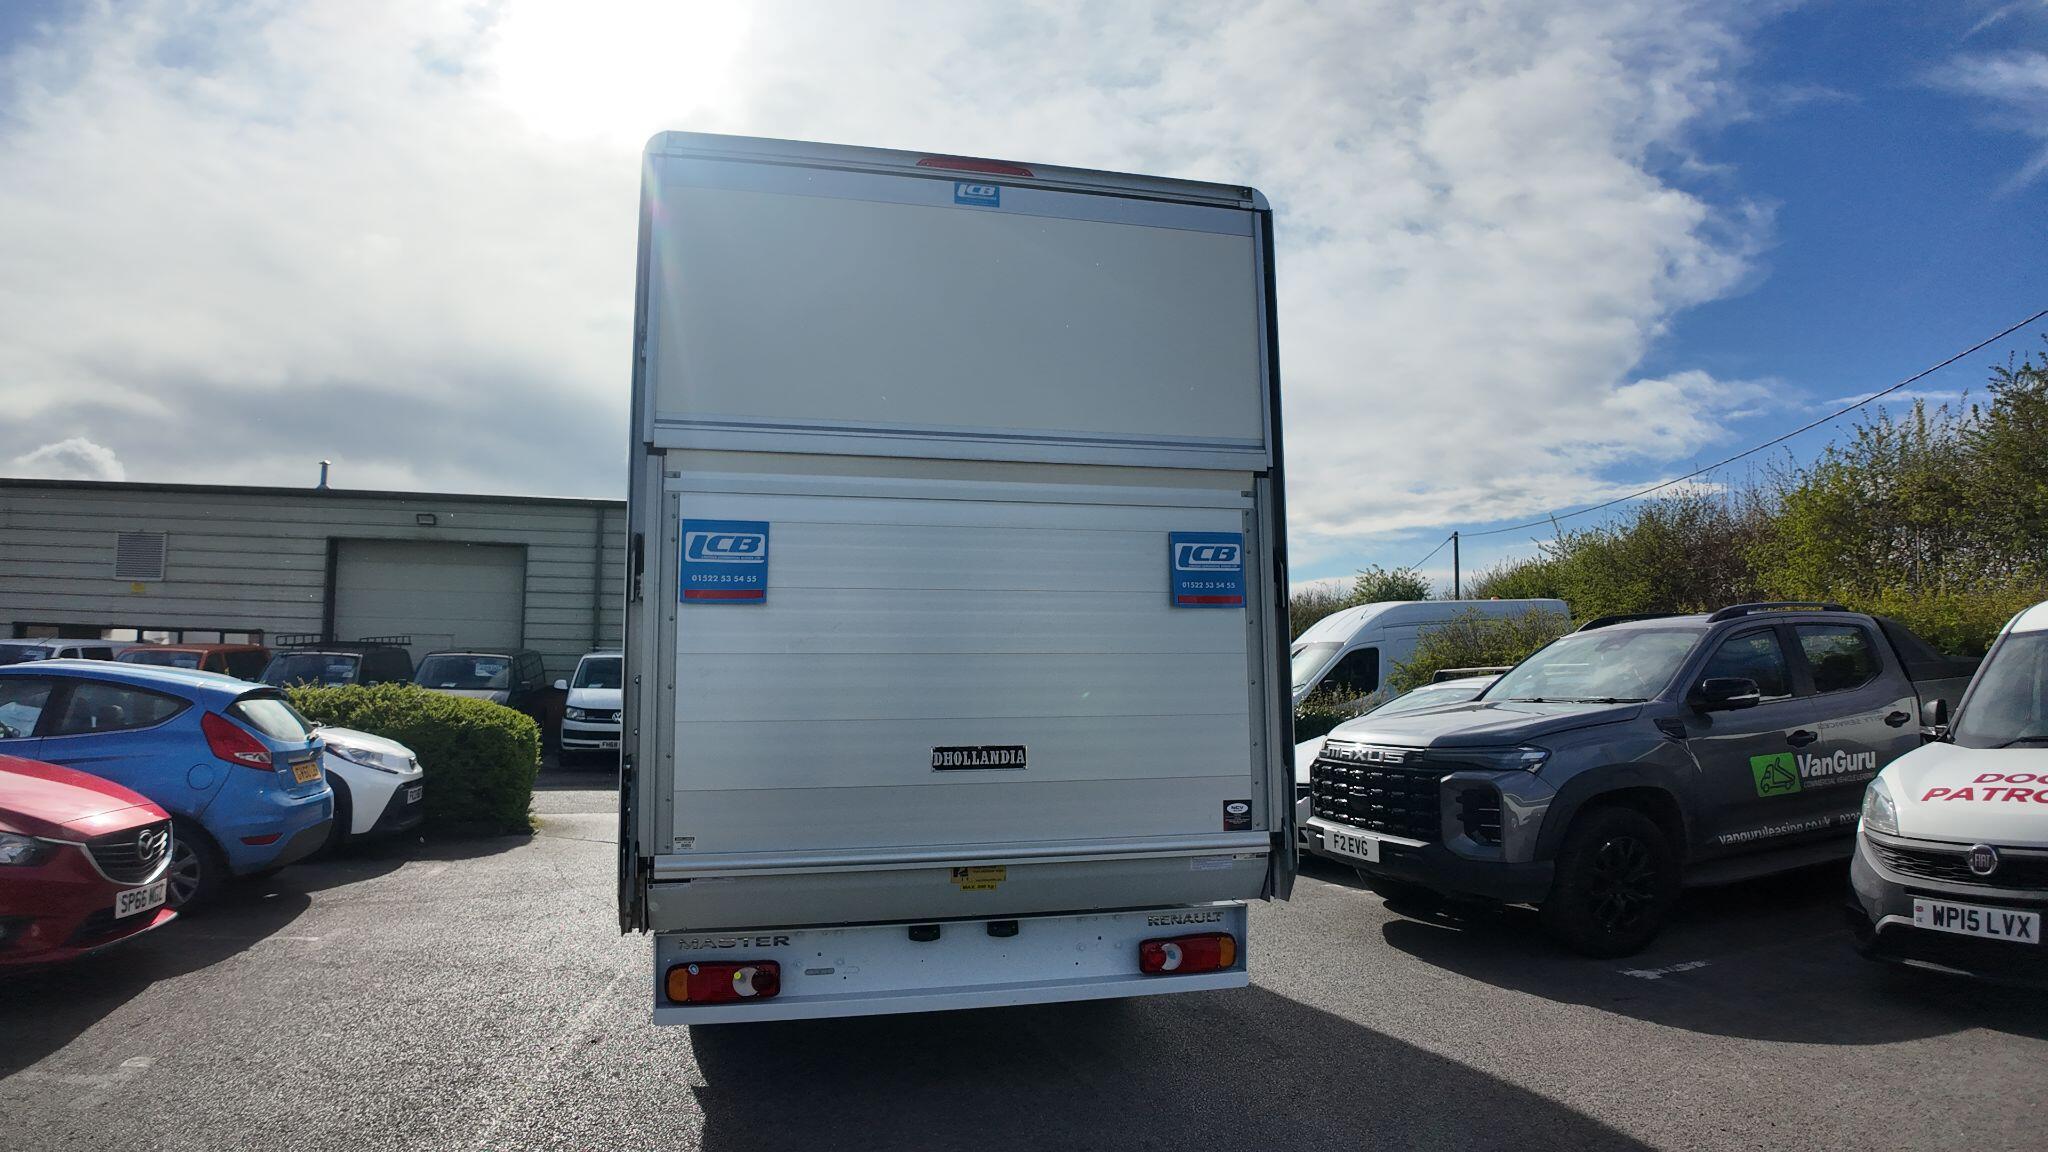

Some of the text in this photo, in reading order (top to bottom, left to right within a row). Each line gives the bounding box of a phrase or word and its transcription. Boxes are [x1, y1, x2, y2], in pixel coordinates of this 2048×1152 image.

[958, 184, 996, 197] LCB
[689, 535, 762, 559] LCB
[1178, 545, 1237, 567] LCB
[691, 574, 757, 583] 01522 53 54 55
[1182, 581, 1204, 589] 01522
[932, 749, 1026, 766] DHOLLANDIA
[1327, 746, 1405, 764] MAXUS
[1797, 749, 1876, 778] VanGuru
[1333, 833, 1369, 857] F2 EVG
[1974, 853, 1991, 867] FIAT
[121, 890, 148, 914] SP66
[1148, 911, 1224, 927] RENAULT
[1932, 905, 2031, 938] WP15 LVX
[680, 935, 790, 950] MASTER
